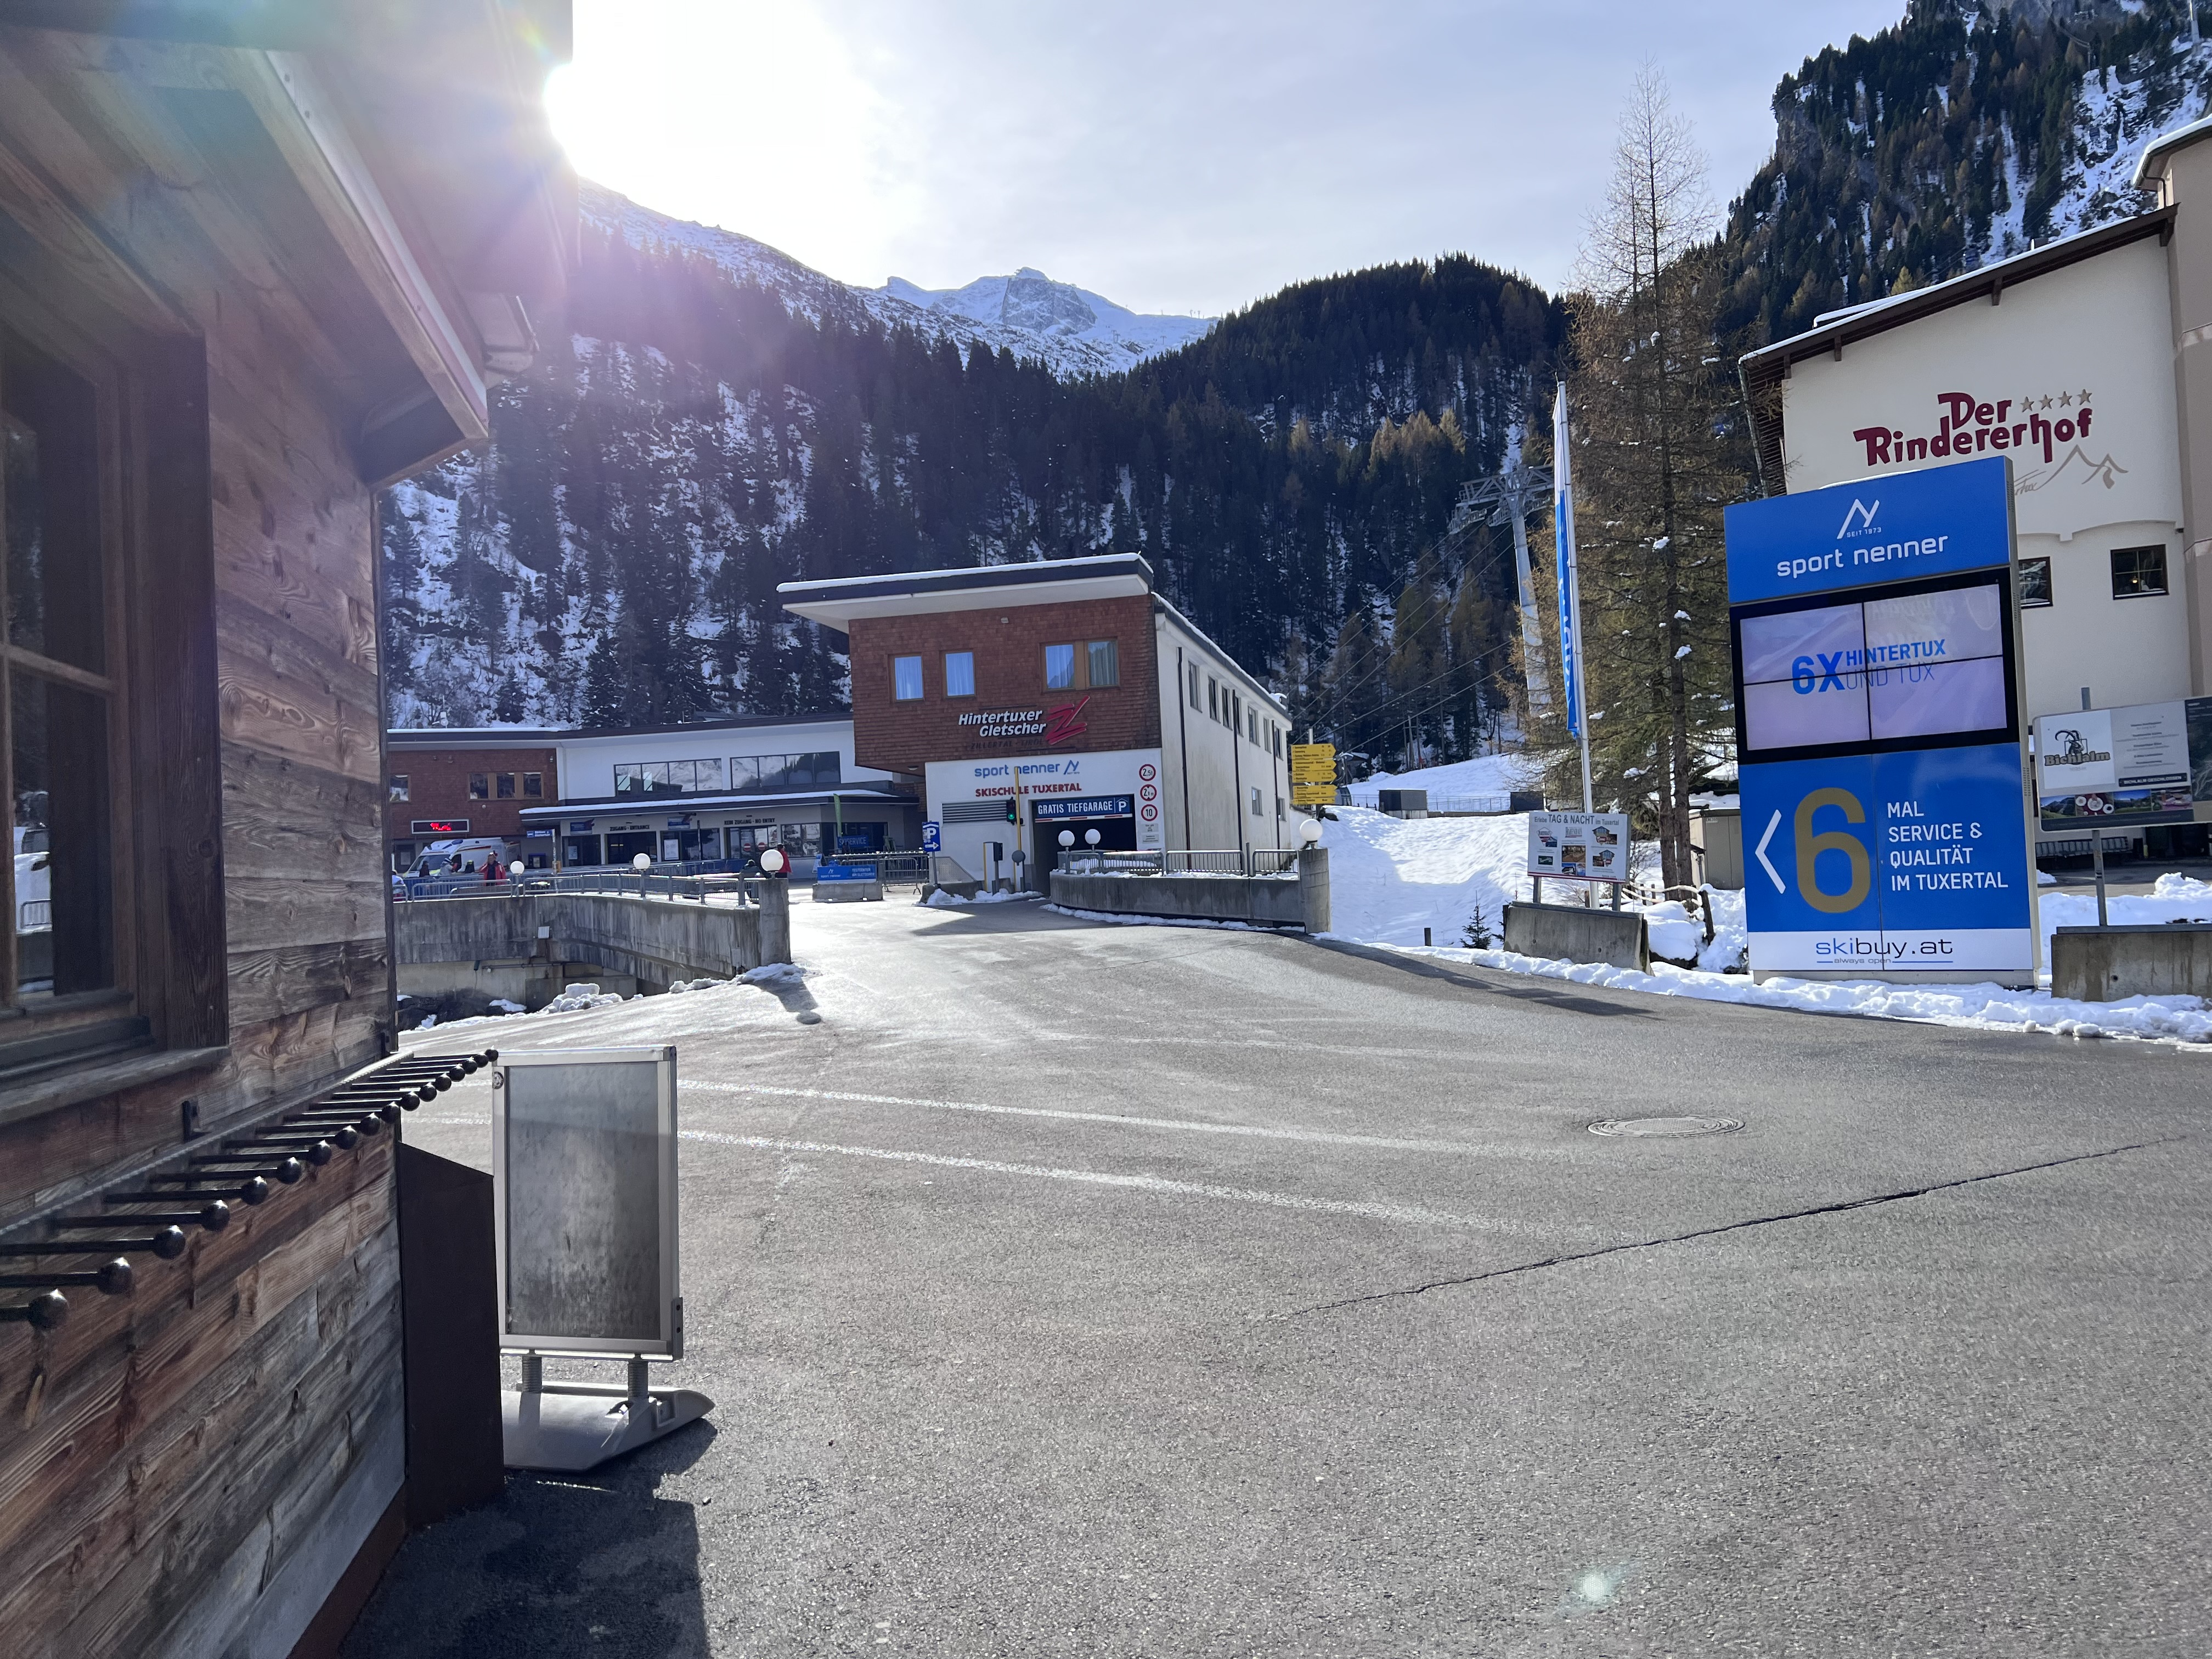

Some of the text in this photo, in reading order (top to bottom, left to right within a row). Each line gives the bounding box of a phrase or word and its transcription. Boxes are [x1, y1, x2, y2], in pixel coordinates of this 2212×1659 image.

[1937, 392, 2012, 430] Der
[1853, 408, 2092, 466] Rindererhof
[1847, 527, 1882, 538] SEIT 1973
[1777, 535, 1948, 578] sport nenner
[1792, 639, 1946, 695] 6X HINTERTUX
[1846, 659, 1935, 690] UND TUX
[958, 710, 1043, 725] Hintertuxer
[979, 723, 1047, 737] Gletscher
[2044, 751, 2111, 766] Bichlalm
[974, 763, 1060, 778] sport nenner
[975, 783, 1081, 797] SKISCHULE TUXERTAL
[1038, 800, 1127, 814] GRATIS TIEFGARAGE P
[1146, 809, 1153, 817] 10
[1887, 801, 1925, 819] MAL
[1548, 814, 1561, 823] TAG
[1564, 815, 1568, 823] &
[1570, 815, 1595, 825] NACHT
[927, 827, 936, 839] P
[1888, 822, 1983, 843] SERVICE &
[839, 837, 867, 846] SKISERVICE
[1794, 787, 1871, 913] 6
[1890, 844, 1973, 868] QUALITÄT
[1892, 872, 2008, 891] IM TUXERTAL
[1816, 938, 1953, 958] skibuy.at
